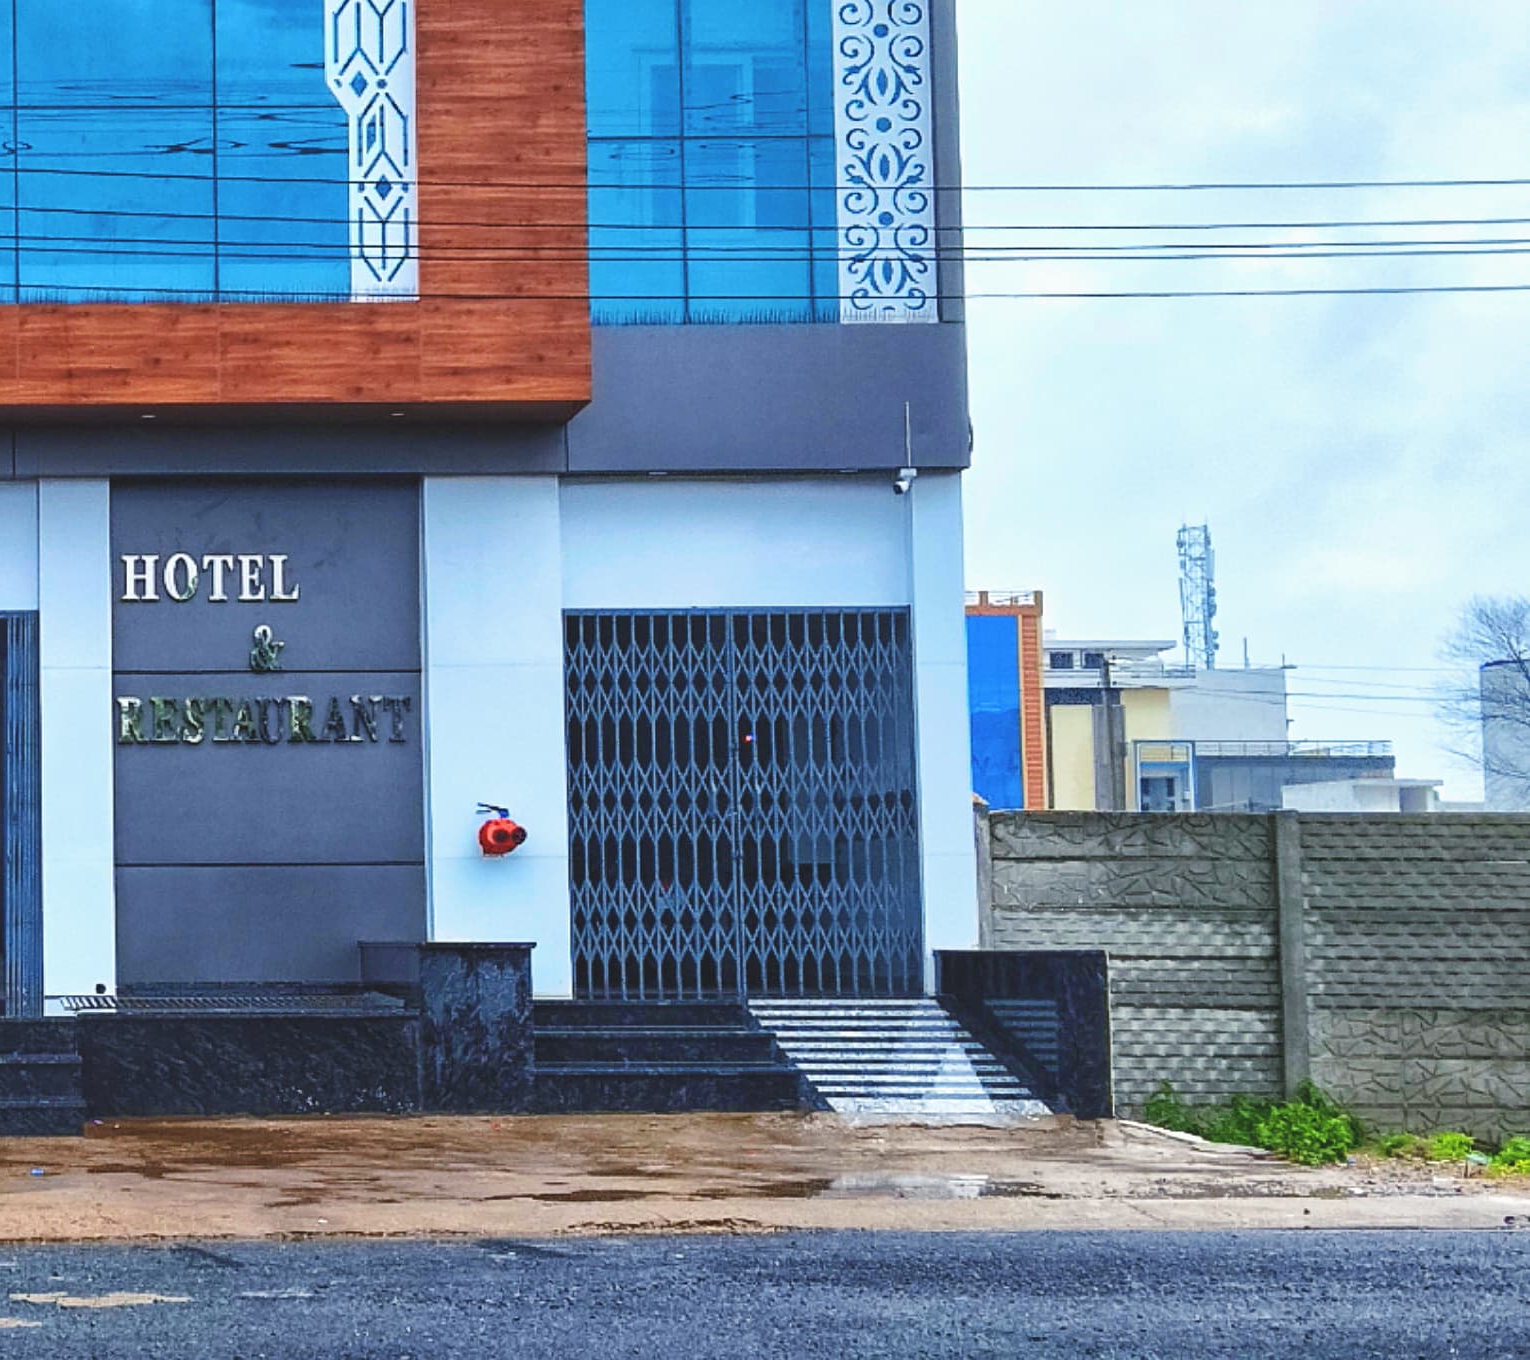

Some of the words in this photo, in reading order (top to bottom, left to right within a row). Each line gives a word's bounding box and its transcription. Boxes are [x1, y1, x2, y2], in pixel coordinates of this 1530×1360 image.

[120, 552, 300, 602] HOTEL
[249, 624, 286, 672] &
[116, 695, 412, 744] RESTAURANT
